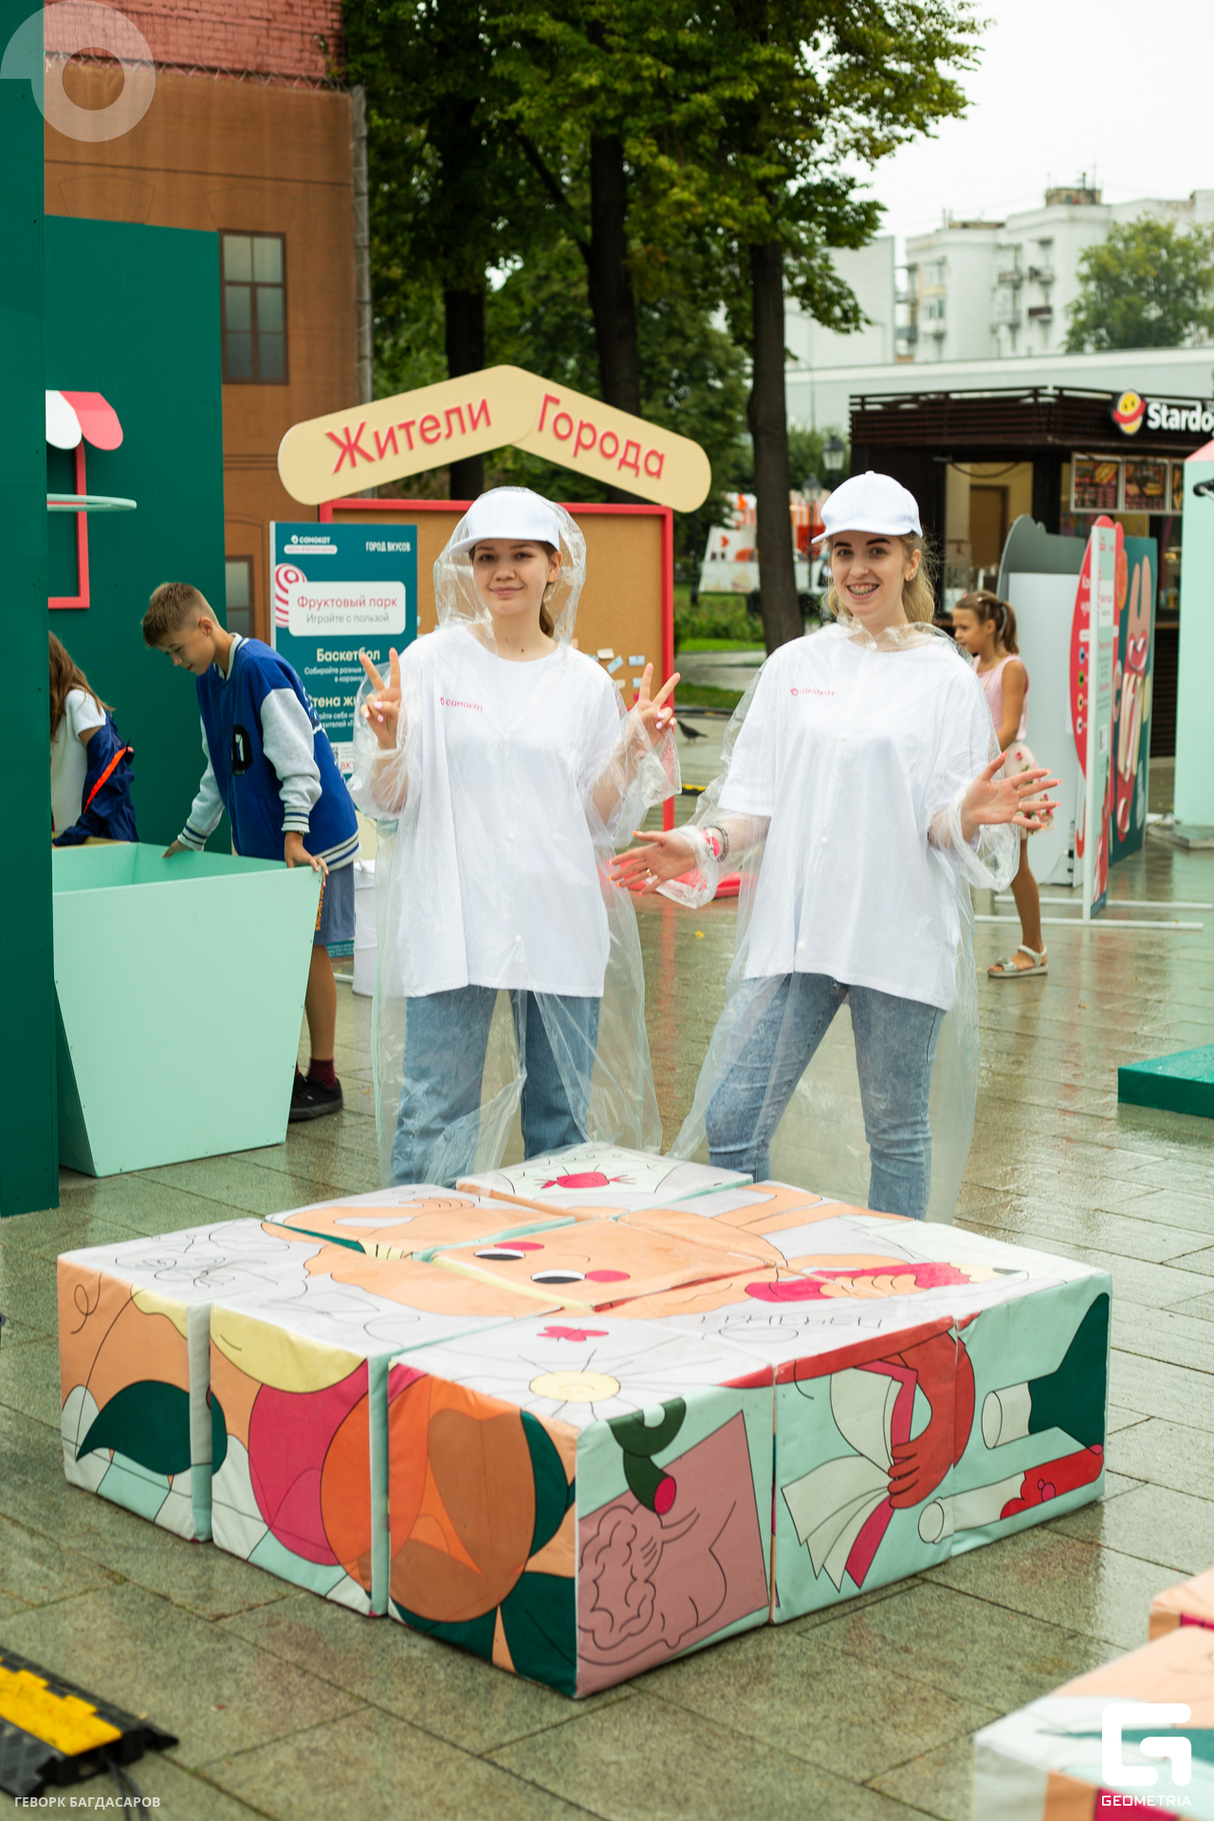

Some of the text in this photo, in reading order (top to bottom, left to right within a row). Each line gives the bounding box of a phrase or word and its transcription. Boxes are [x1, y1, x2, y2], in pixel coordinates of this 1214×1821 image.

[1147, 401, 1214, 436] Stardo
[325, 393, 665, 480] Жители Города
[365, 541, 411, 552] ГОРОД ВКУСОВ
[297, 595, 398, 611] Фруктовый парк
[306, 612, 389, 625] Играйте с пользой
[317, 647, 380, 662] Баскетбол
[304, 666, 362, 676] Собирайте разные
[318, 711, 332, 720] айте
